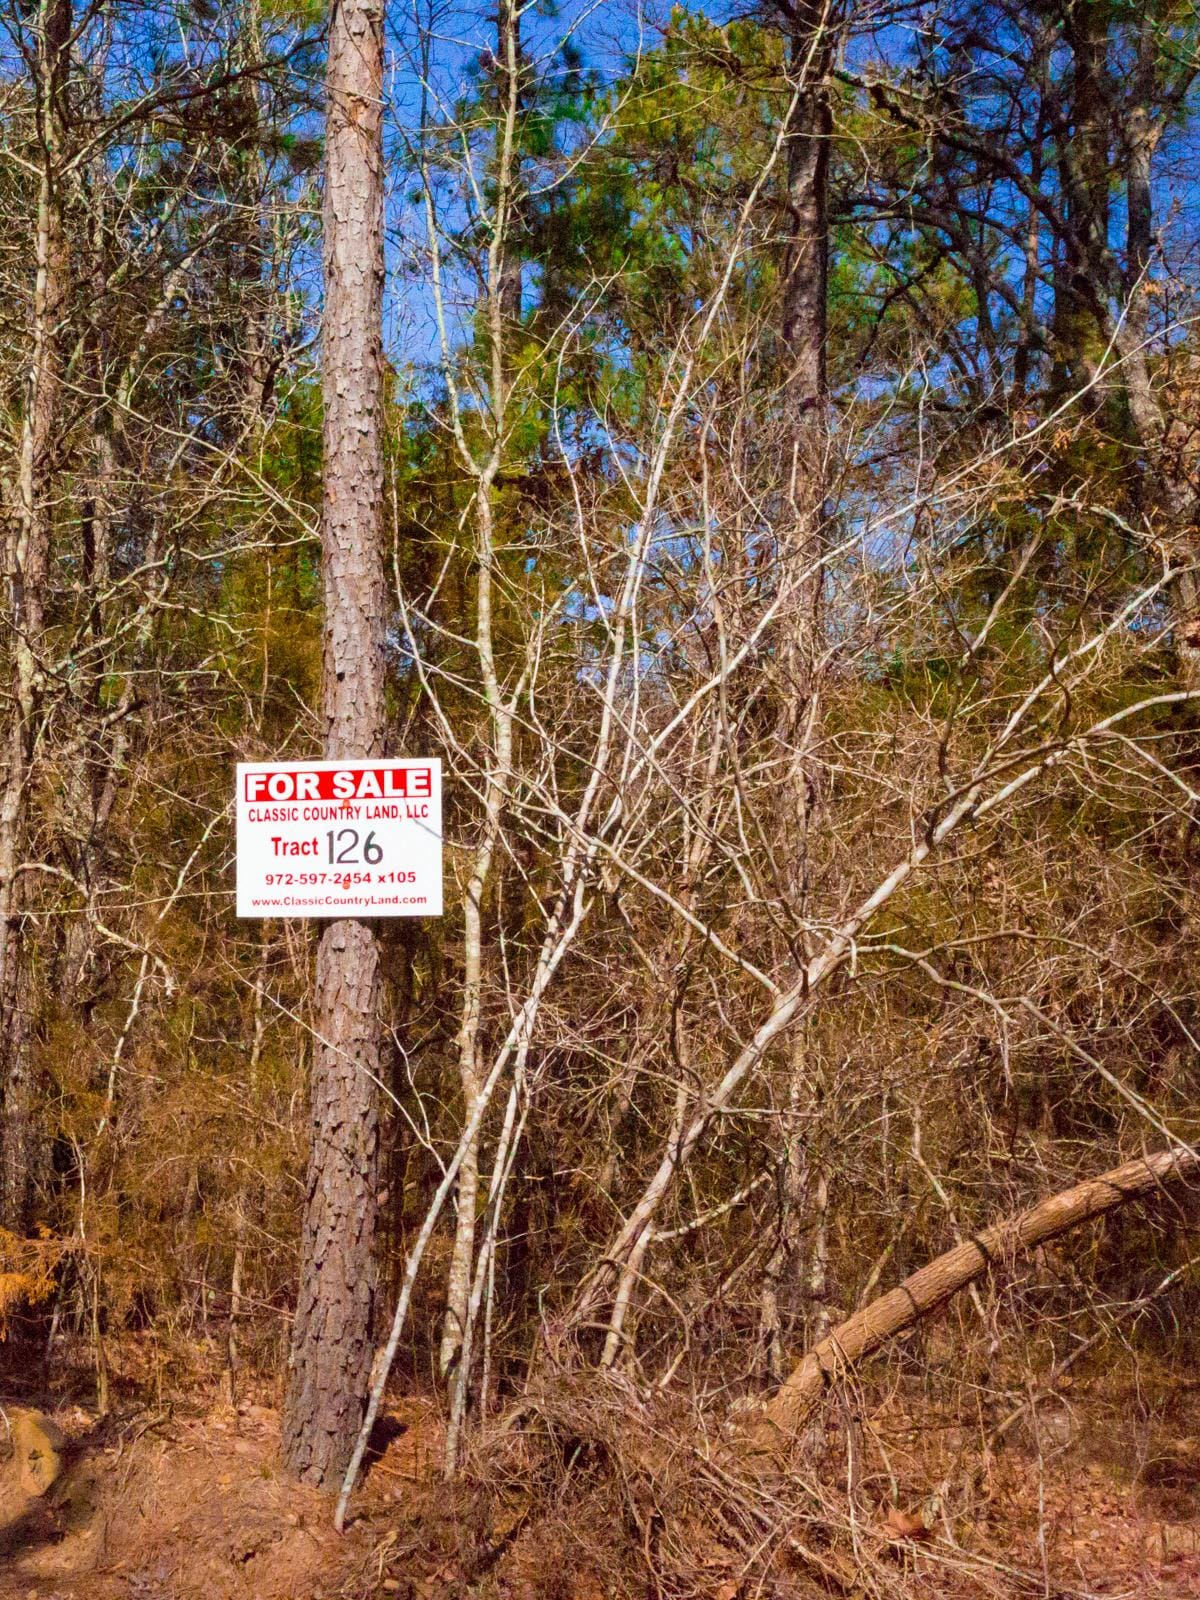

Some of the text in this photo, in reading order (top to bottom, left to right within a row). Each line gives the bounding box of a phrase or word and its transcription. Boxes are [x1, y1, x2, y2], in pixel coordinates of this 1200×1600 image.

[246, 769, 430, 801] FOR SALE
[248, 804, 429, 822] CLASSIC COUNTRY LAND, LLC
[271, 828, 384, 865] Tract 126
[265, 871, 417, 886] 972-597-2454 x105
[252, 895, 427, 907] www.ClassicCountryLand.com
